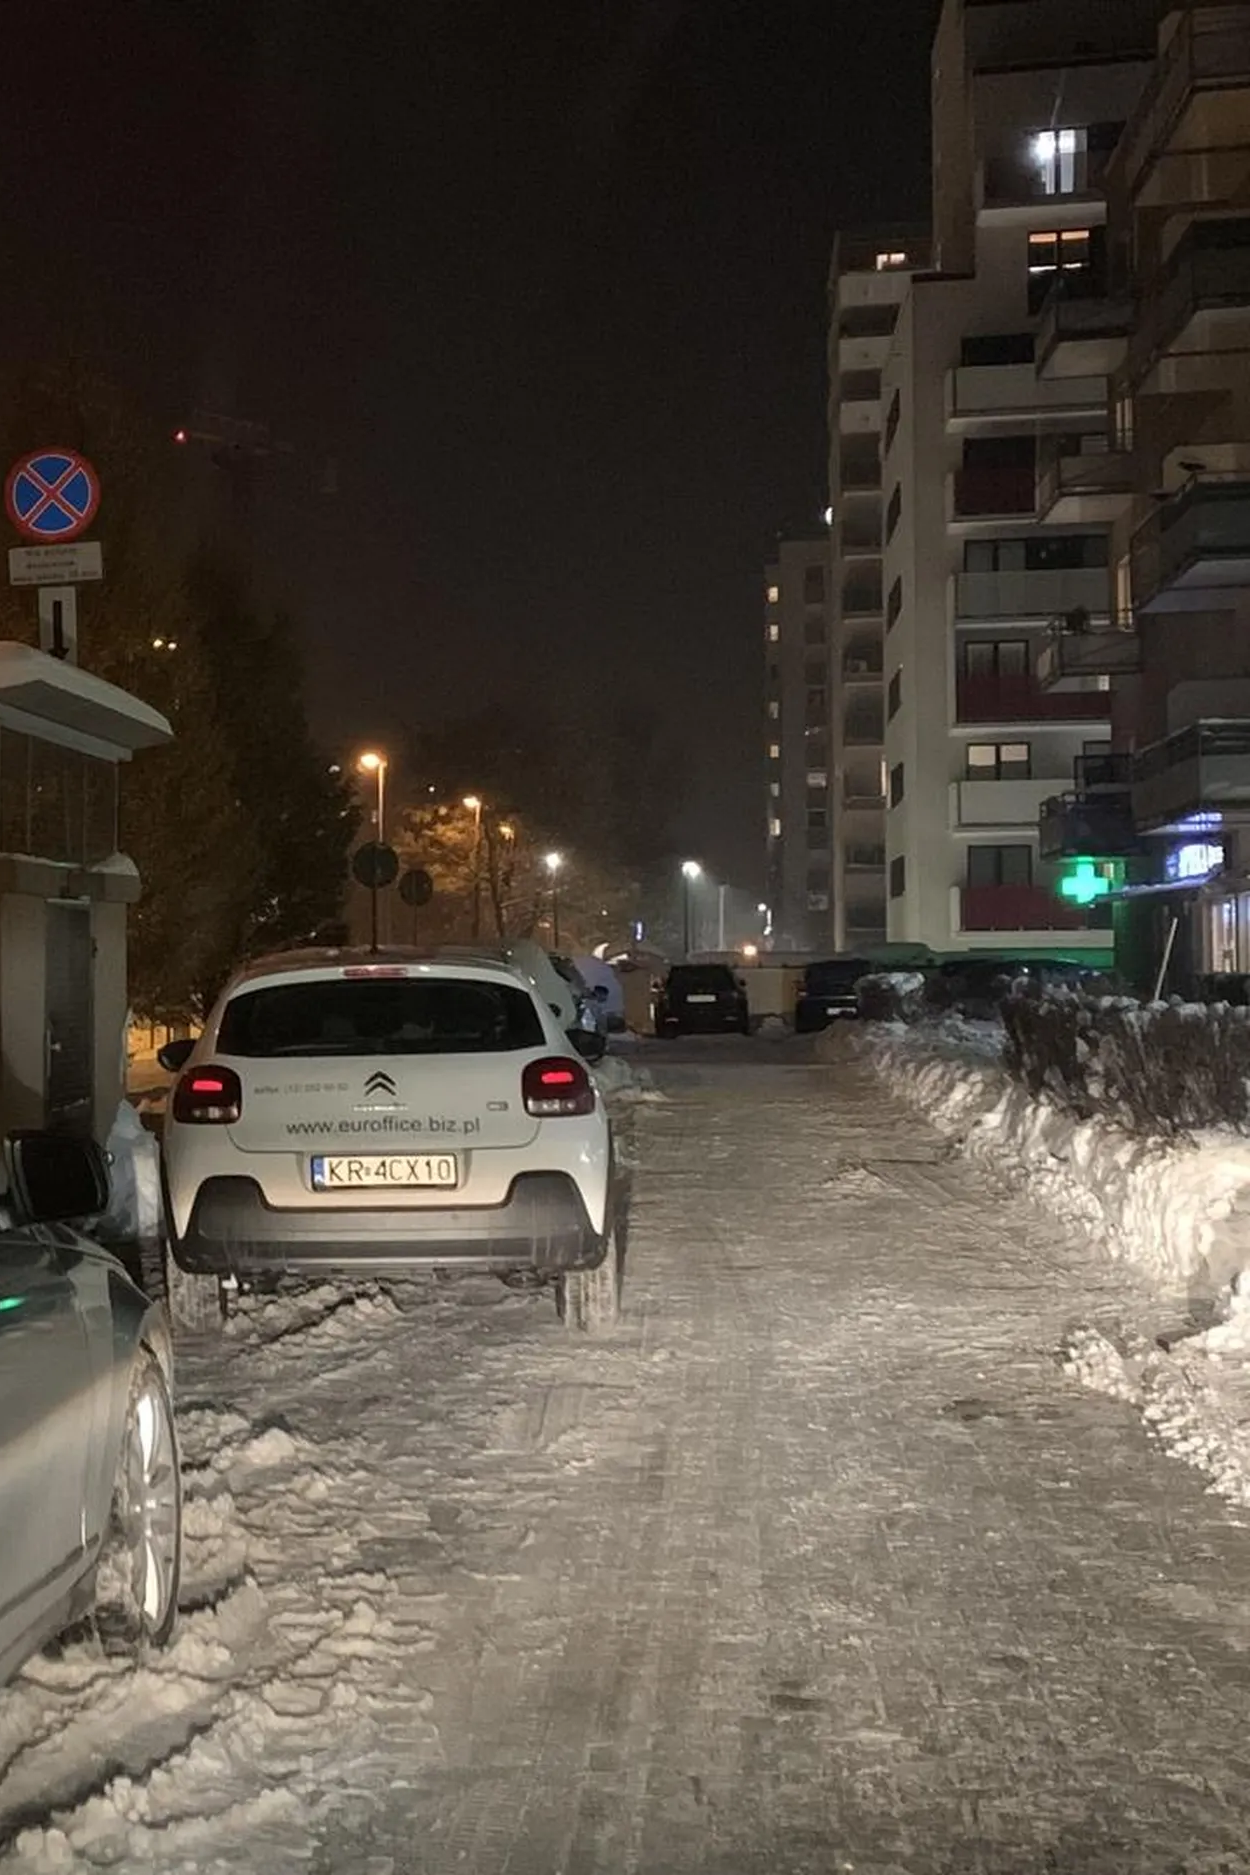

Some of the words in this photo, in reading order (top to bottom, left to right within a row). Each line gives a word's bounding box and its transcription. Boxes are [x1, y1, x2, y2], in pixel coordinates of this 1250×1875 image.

[286, 1115, 480, 1135] www.euroffice.biz.pl
[328, 1159, 363, 1182] KR
[374, 1159, 451, 1181] 4CX10
